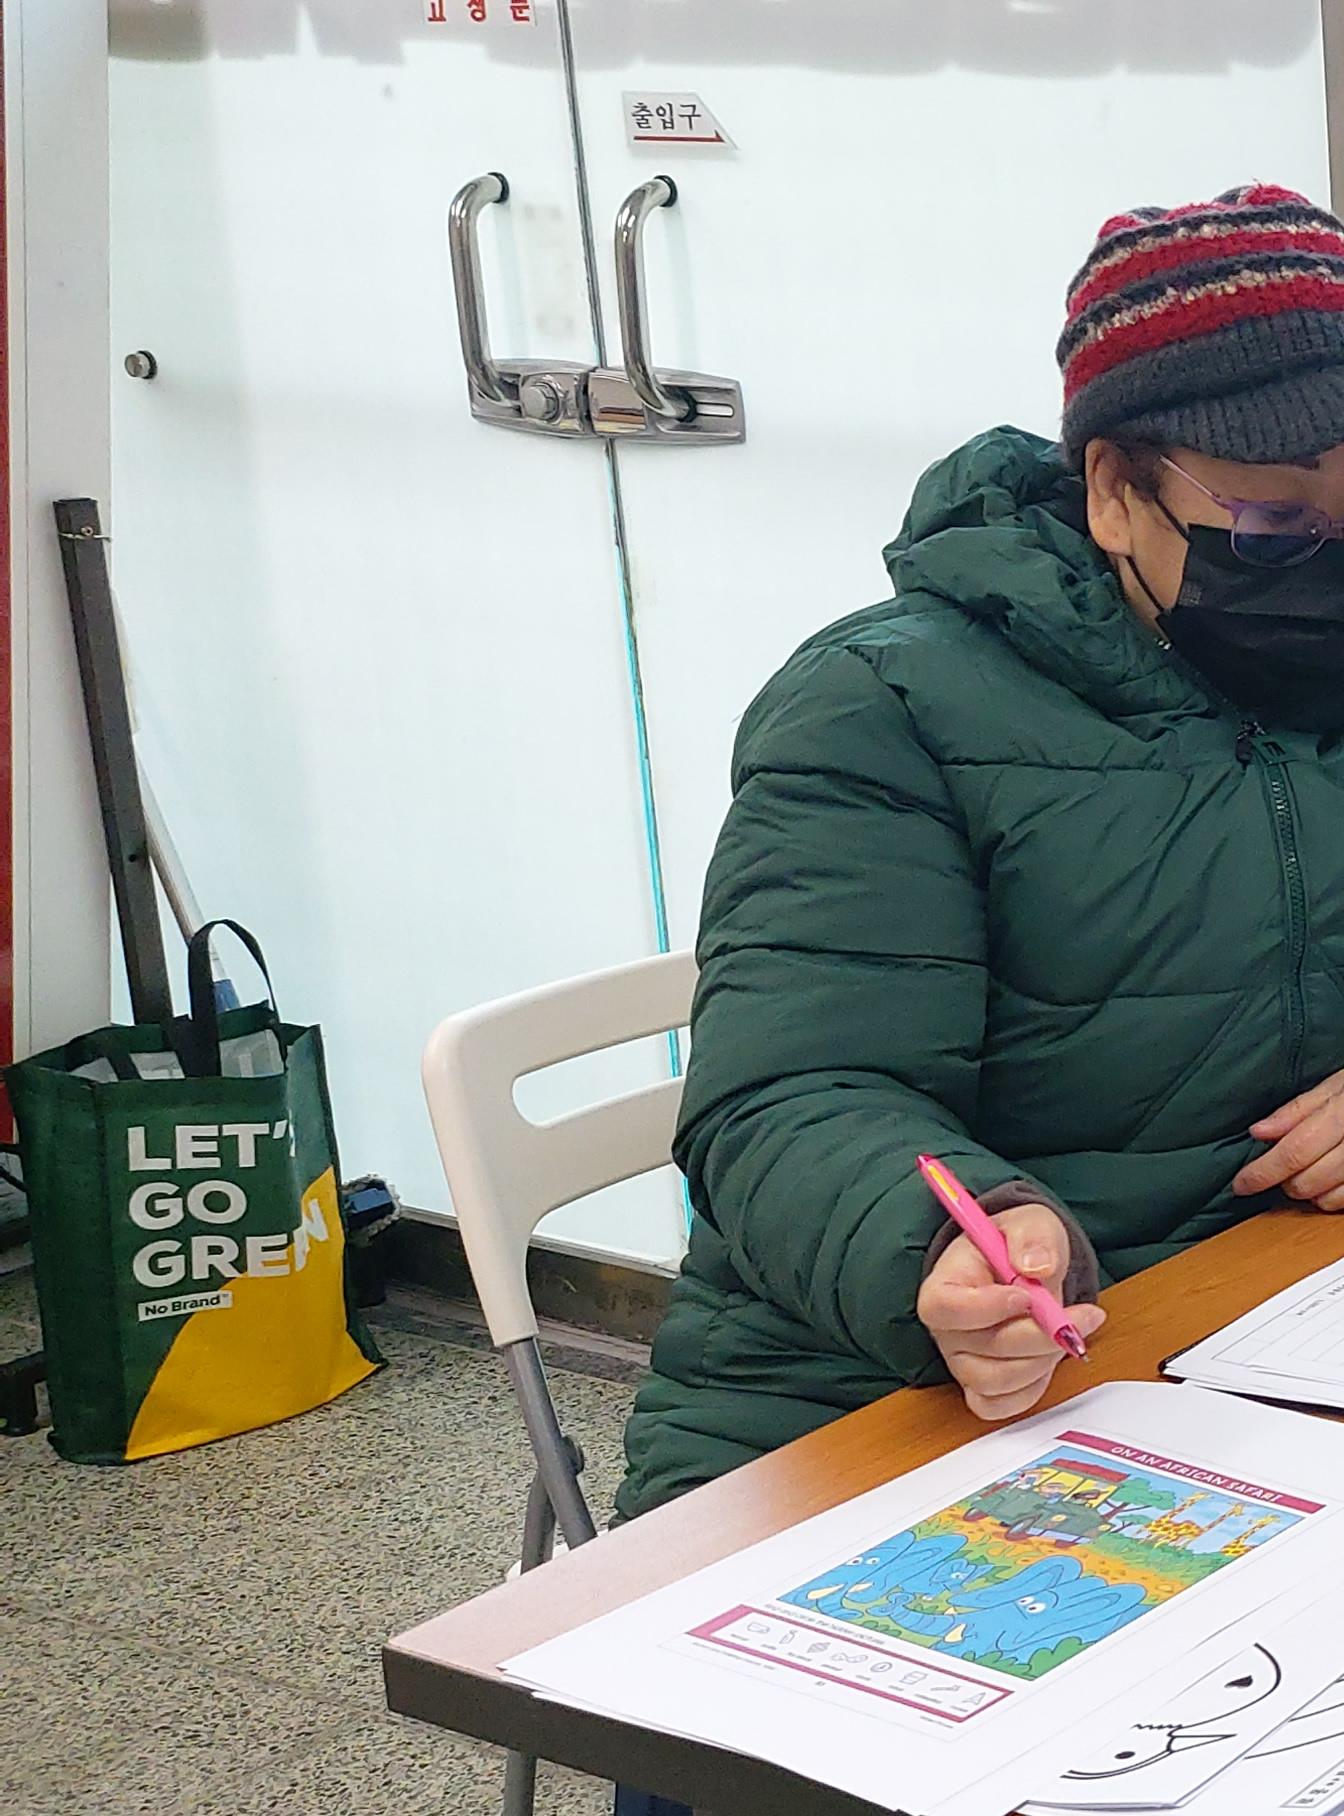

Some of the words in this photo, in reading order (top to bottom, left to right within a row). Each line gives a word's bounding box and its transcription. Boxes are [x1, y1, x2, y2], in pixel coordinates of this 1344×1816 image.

[631, 102, 703, 131] 출입구
[127, 1113, 296, 1172] LET'
[128, 1180, 248, 1231] GO
[132, 1198, 330, 1289] GREN
[144, 1302, 167, 1317] No
[171, 1295, 222, 1314] Brand
[1111, 1446, 1135, 1459] ON
[1135, 1453, 1161, 1468] AN
[1160, 1461, 1228, 1487] AFRICAN
[1227, 1479, 1284, 1503] SAFARI
